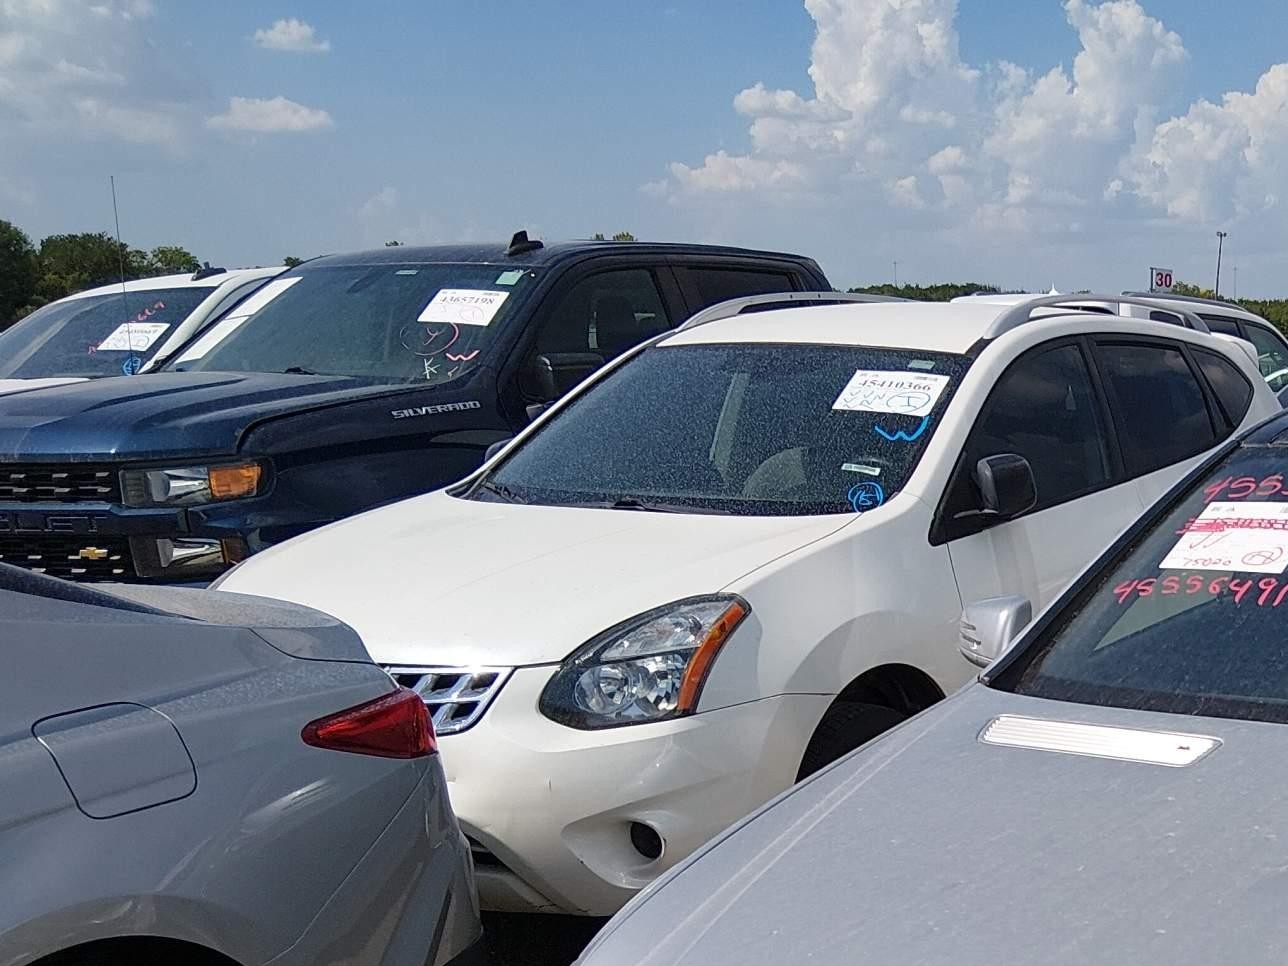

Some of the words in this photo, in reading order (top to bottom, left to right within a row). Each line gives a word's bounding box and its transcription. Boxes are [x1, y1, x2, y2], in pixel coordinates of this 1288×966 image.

[1155, 272, 1172, 288] 30
[859, 379, 932, 391] 45410366
[391, 400, 481, 419] SILVERADO
